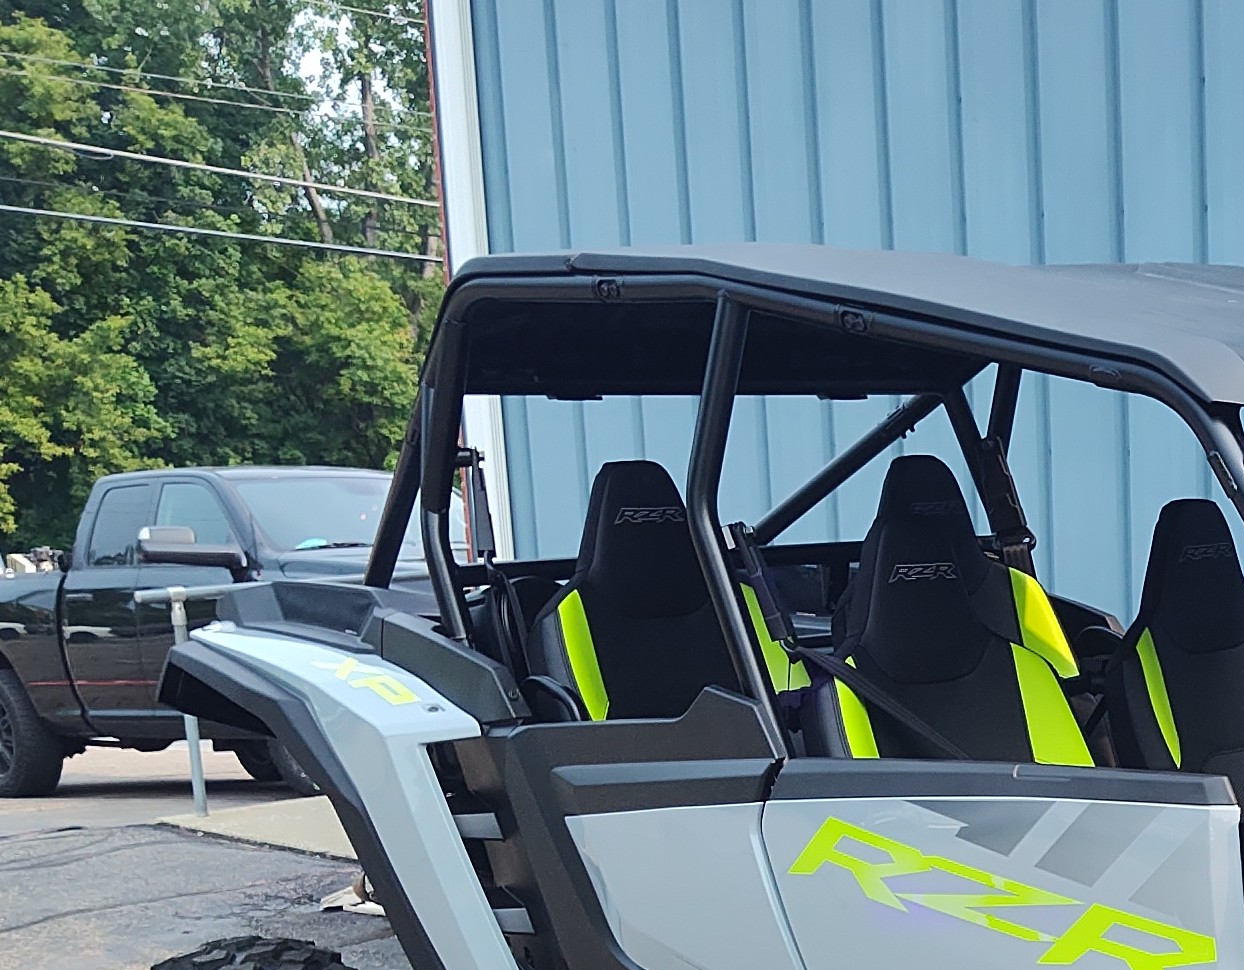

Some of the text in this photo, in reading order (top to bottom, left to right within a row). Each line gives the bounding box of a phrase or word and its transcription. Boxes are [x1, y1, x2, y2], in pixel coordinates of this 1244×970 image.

[614, 507, 685, 524] RZR
[1179, 542, 1234, 562] RZR
[888, 562, 957, 583] RZR
[311, 656, 421, 706] XP
